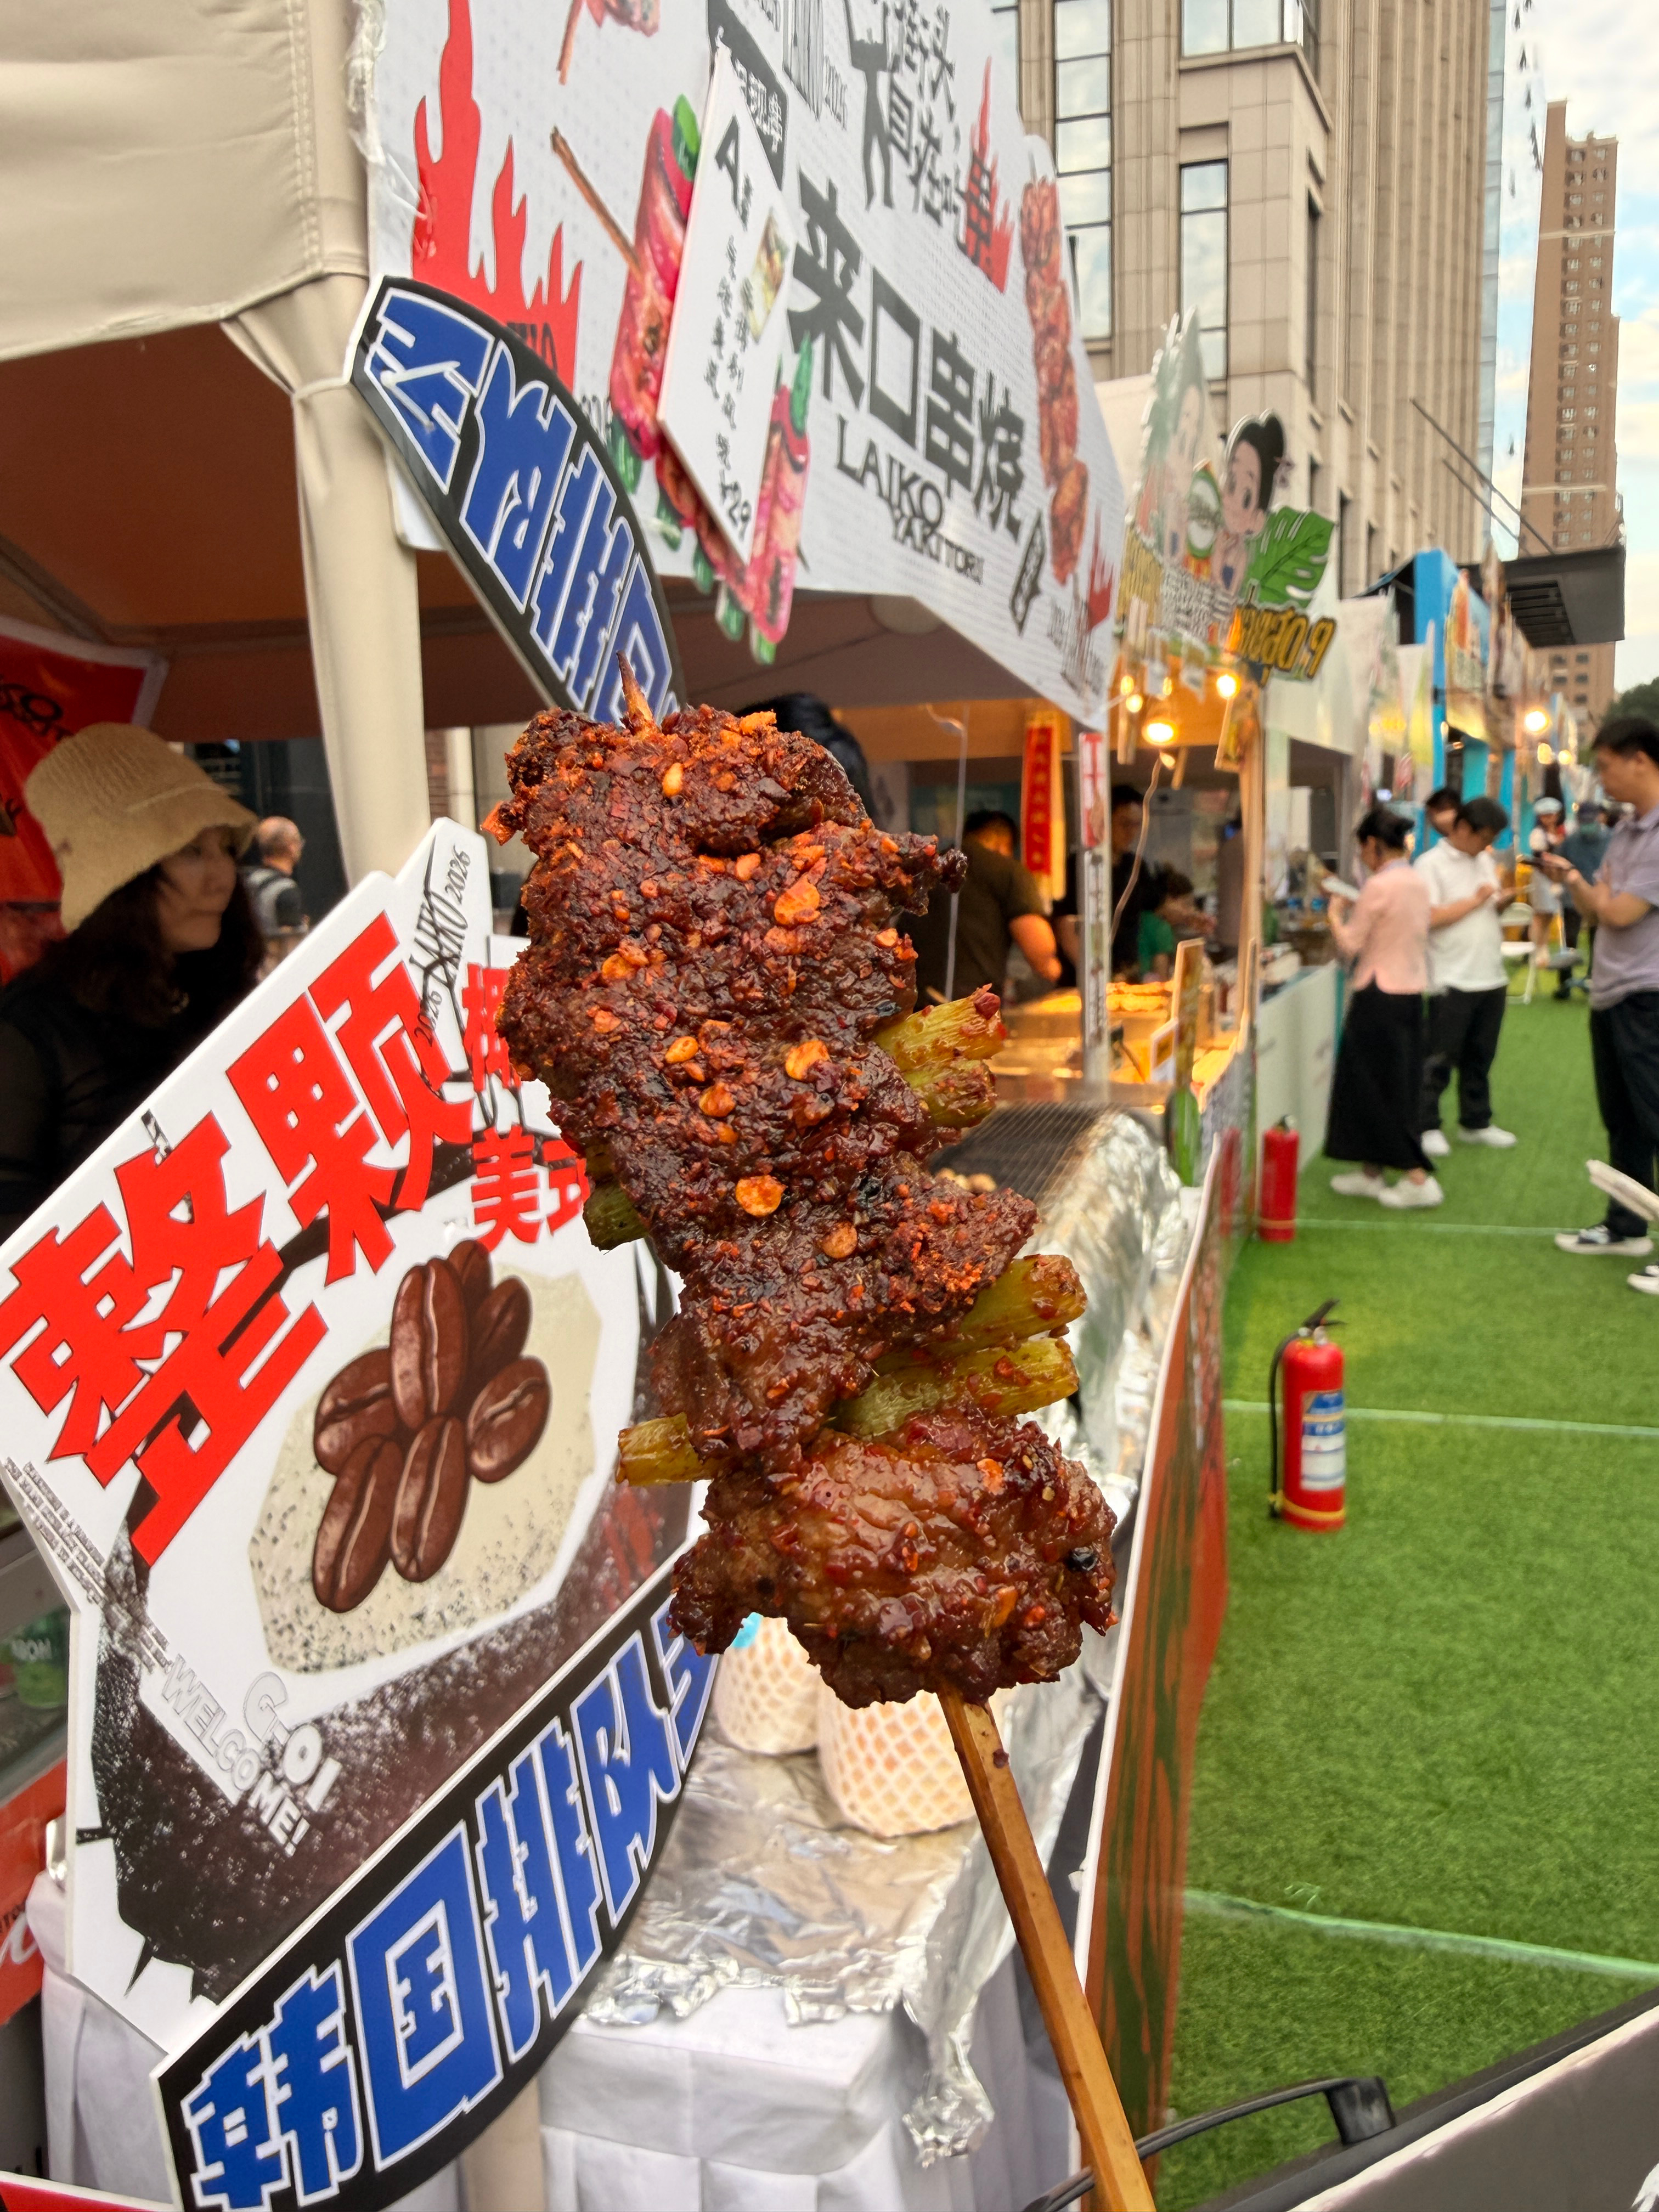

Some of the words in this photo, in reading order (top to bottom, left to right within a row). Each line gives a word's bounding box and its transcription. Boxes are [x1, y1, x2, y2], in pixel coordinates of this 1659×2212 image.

[787, 163, 1025, 542] 来口串烧
[836, 413, 944, 528] LAIKO
[444, 843, 472, 906] 2026
[0, 910, 474, 1567] 整颗
[160, 1654, 311, 1857] WELCOME!
